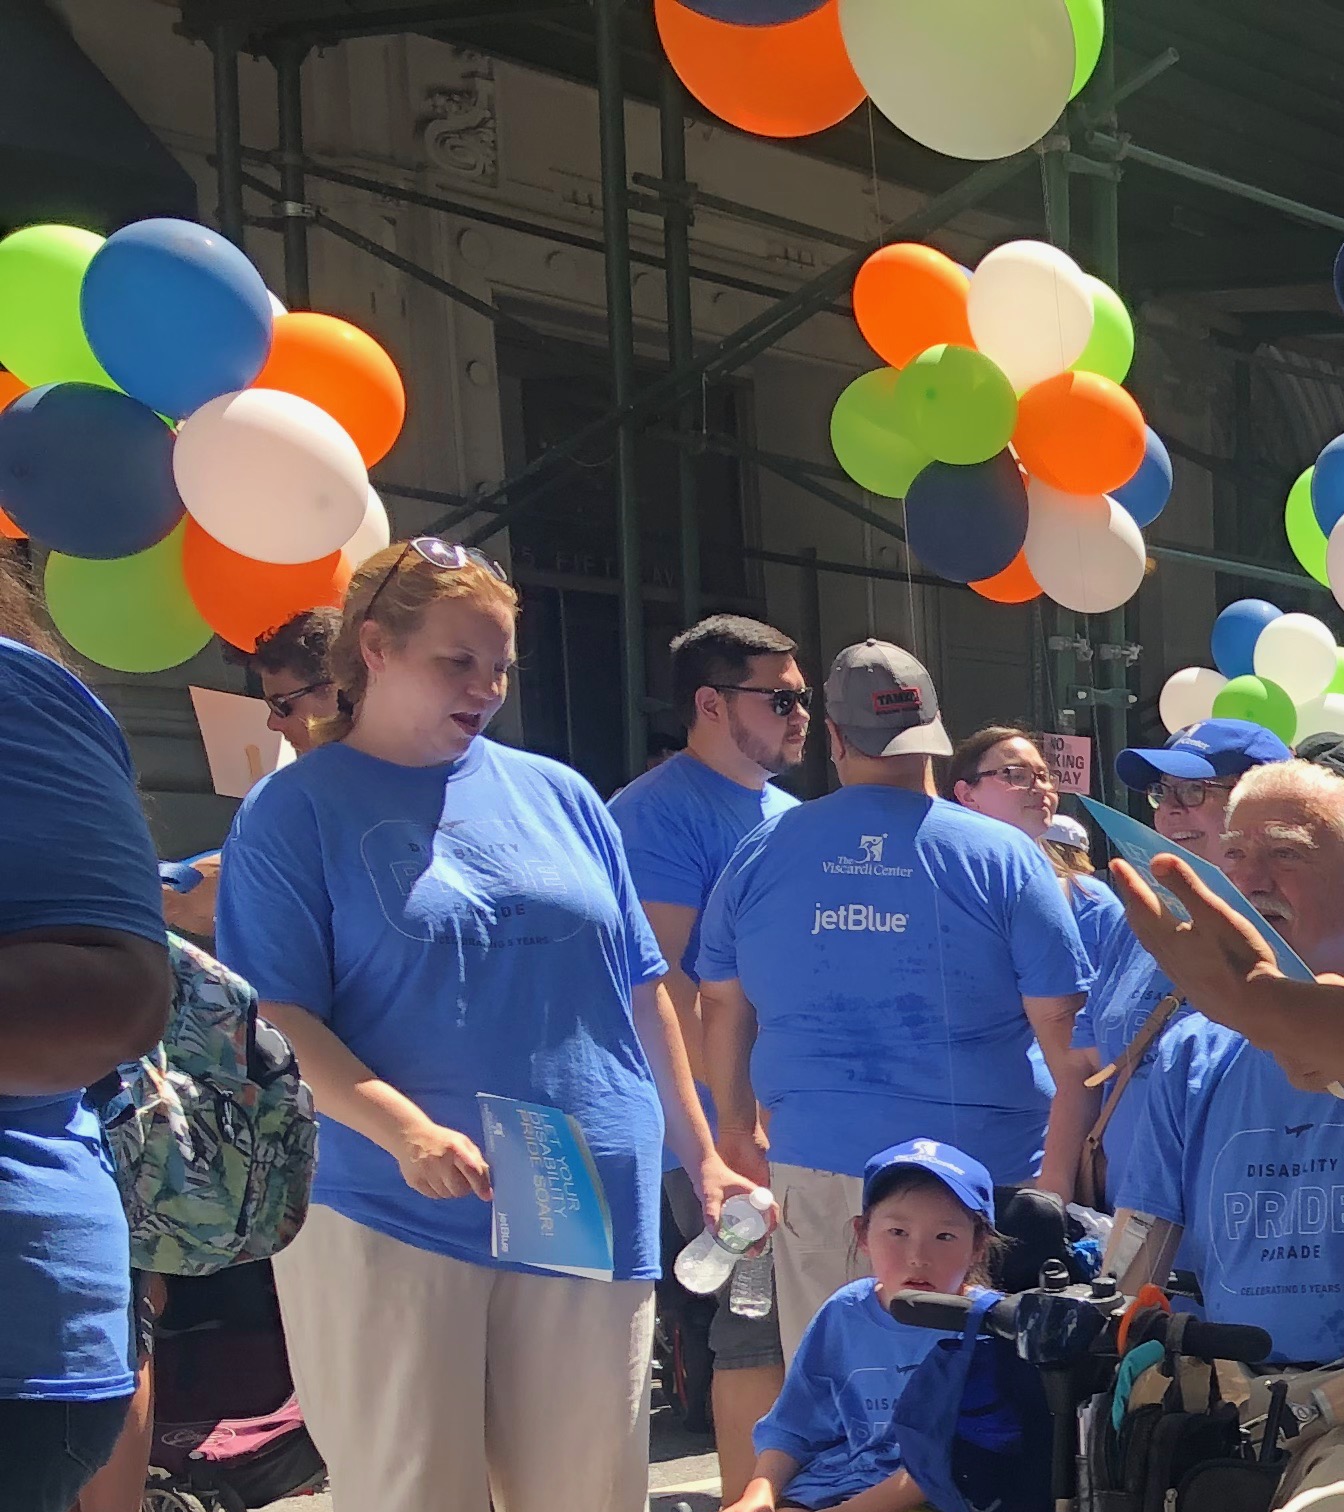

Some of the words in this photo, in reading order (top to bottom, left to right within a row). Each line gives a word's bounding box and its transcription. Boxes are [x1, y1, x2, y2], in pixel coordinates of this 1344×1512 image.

[823, 861, 872, 875] Viscardi
[873, 865, 914, 877] Center
[811, 902, 906, 935] jetBlue
[525, 1110, 568, 1219] DISABILITY
[556, 1155, 581, 1211] YOUR
